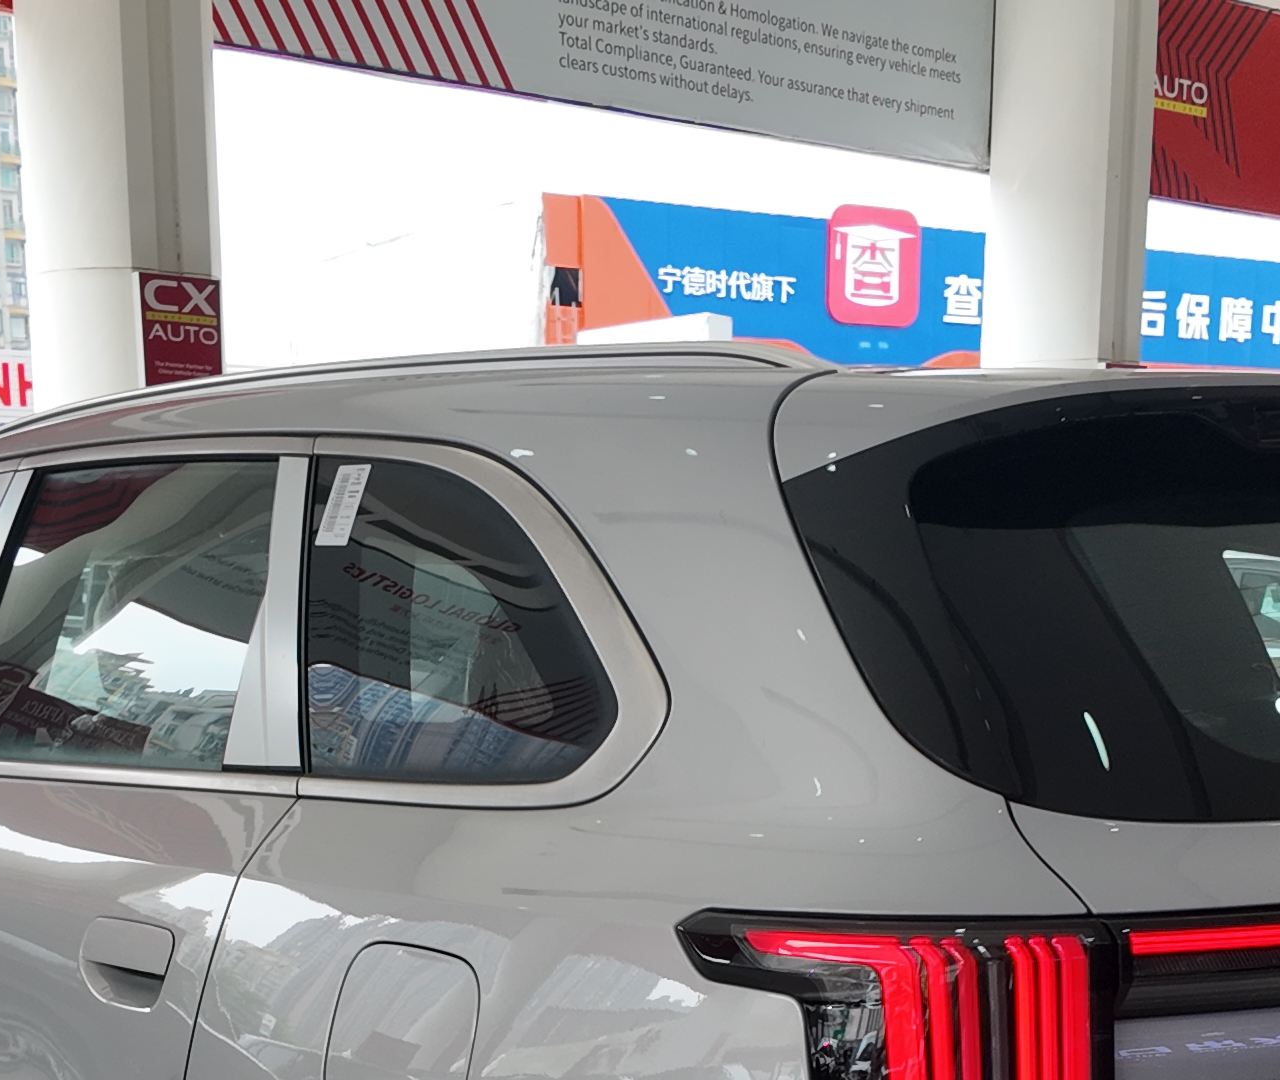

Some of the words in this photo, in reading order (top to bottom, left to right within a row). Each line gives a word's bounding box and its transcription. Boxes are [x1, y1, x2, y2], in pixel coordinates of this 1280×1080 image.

[558, 12, 590, 29] your
[592, 18, 650, 42] market's
[652, 30, 718, 54] standards.
[630, 4, 644, 18] of
[647, 8, 728, 36] international
[730, 24, 801, 54] regulations,
[804, 40, 854, 66] ensuring
[856, 53, 886, 72] every
[889, 57, 927, 76] vehicle
[929, 67, 962, 84] meets
[718, 1, 727, 15] &
[730, 4, 818, 35] Homologation.
[822, 22, 839, 40] We
[842, 30, 889, 50] navigate
[892, 38, 909, 54] the
[912, 44, 957, 64] complex
[558, 53, 599, 74] clears
[602, 62, 657, 85] customs
[660, 72, 709, 94] without
[712, 82, 754, 104] delays.
[559, 31, 592, 52] Total
[595, 38, 677, 70] Compliance,
[680, 54, 755, 83] Guaranteed.
[758, 69, 784, 88] Your
[787, 78, 844, 100] assurance
[847, 88, 870, 105] that
[872, 96, 902, 114] every
[904, 99, 955, 120] shipment
[144, 278, 217, 316] CX
[658, 264, 797, 304] 宁德时代旗下
[942, 273, 983, 326] 查
[148, 322, 218, 346] AUTO
